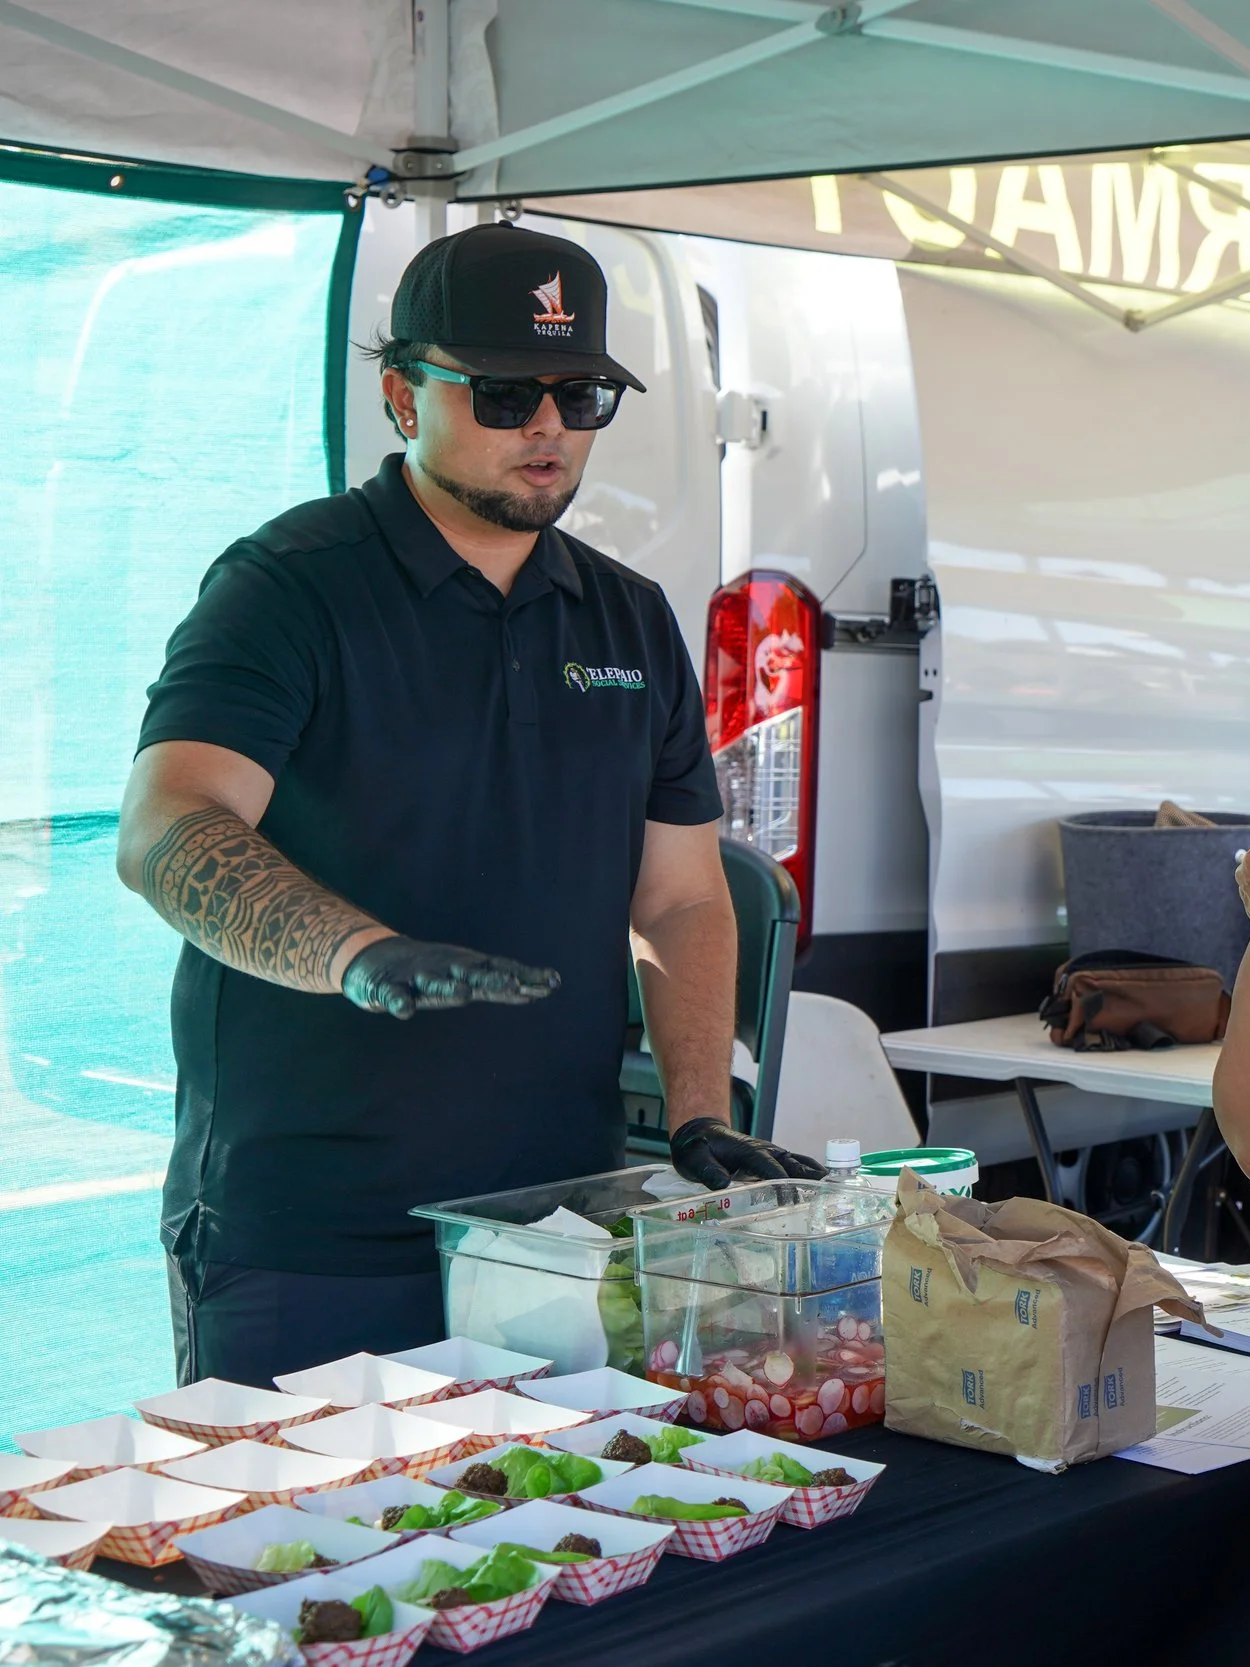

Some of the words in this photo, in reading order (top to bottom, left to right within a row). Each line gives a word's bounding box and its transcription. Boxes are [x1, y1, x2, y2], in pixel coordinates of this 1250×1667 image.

[533, 322, 573, 332] KAPENA
[536, 329, 571, 337] TEQUILA
[591, 679, 618, 687] SOCIAL
[912, 1269, 922, 1302] TORK
[1019, 1291, 1030, 1324] TORK
[1031, 1288, 1041, 1330] Advanced
[966, 1371, 975, 1404] TORK
[977, 1369, 985, 1410] Advanced
[1081, 1384, 1091, 1418] TORK
[1107, 1375, 1117, 1408] TORK
[1117, 1367, 1126, 1407] Advanced
